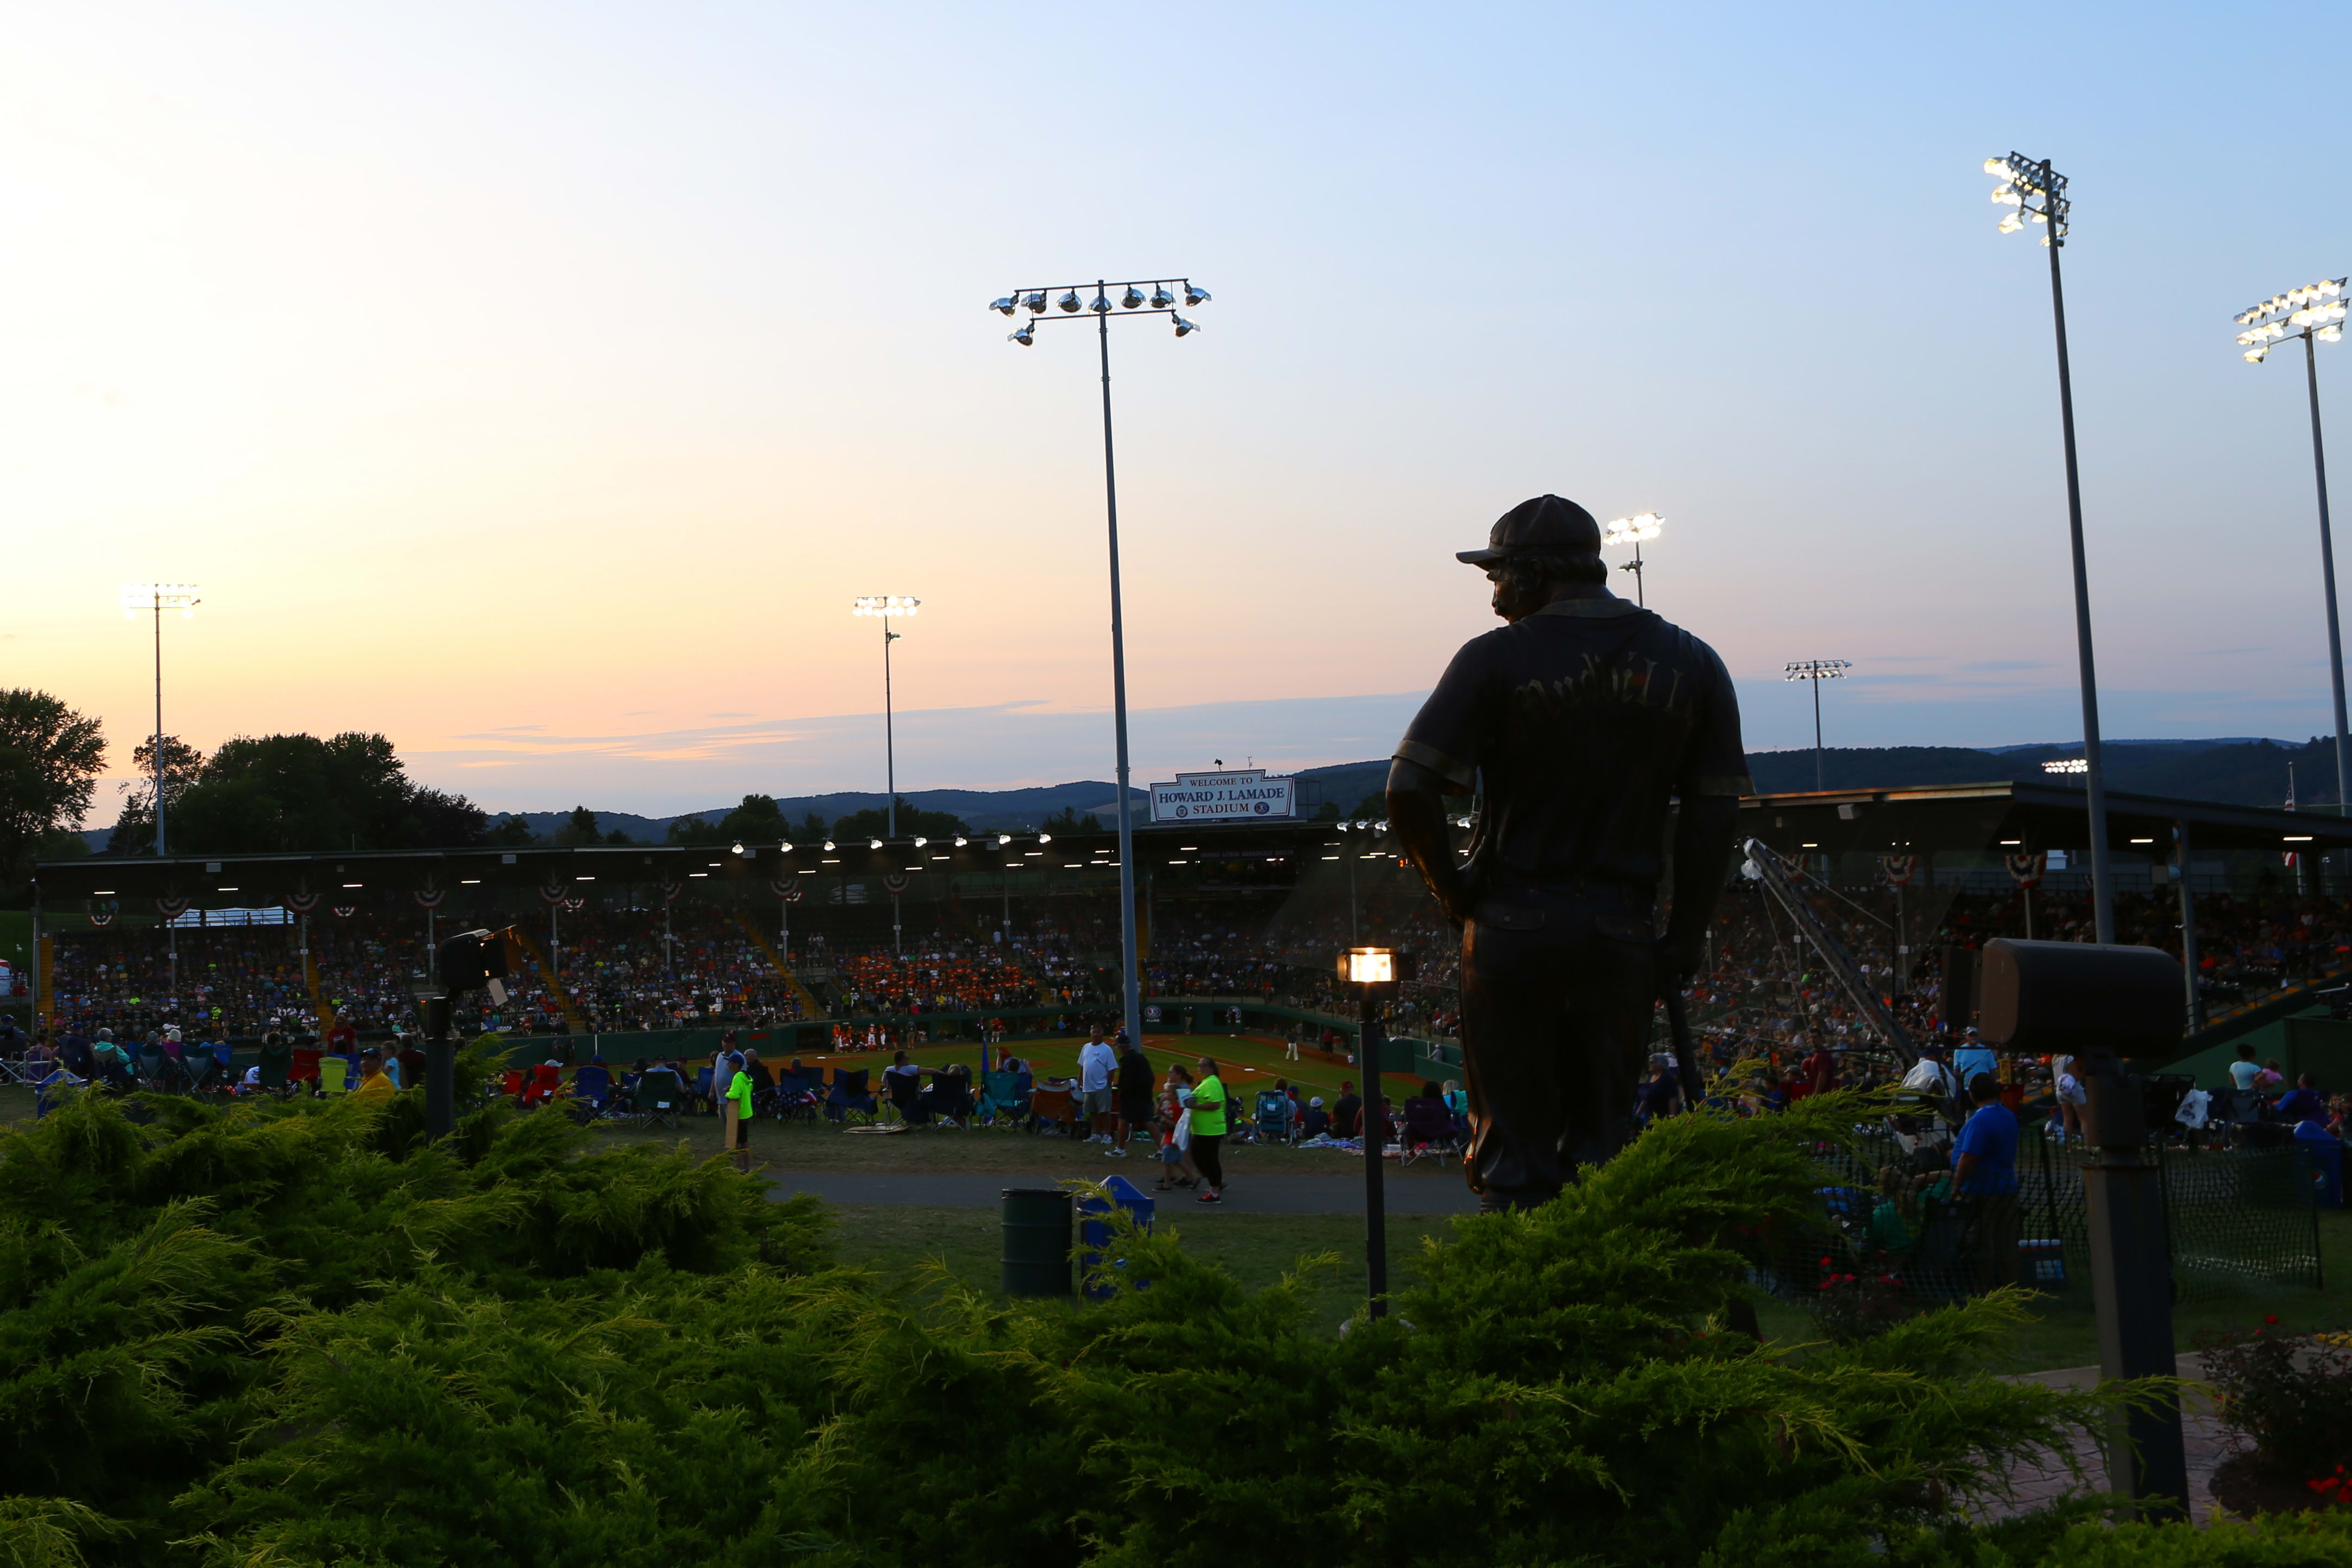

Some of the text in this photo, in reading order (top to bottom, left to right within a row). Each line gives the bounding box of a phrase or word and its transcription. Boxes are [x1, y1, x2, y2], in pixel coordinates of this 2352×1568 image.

[1190, 777, 1237, 787] WELCOME
[1159, 787, 1285, 804] HOWARD J. LAMADE
[1193, 803, 1250, 814] STADIUM
